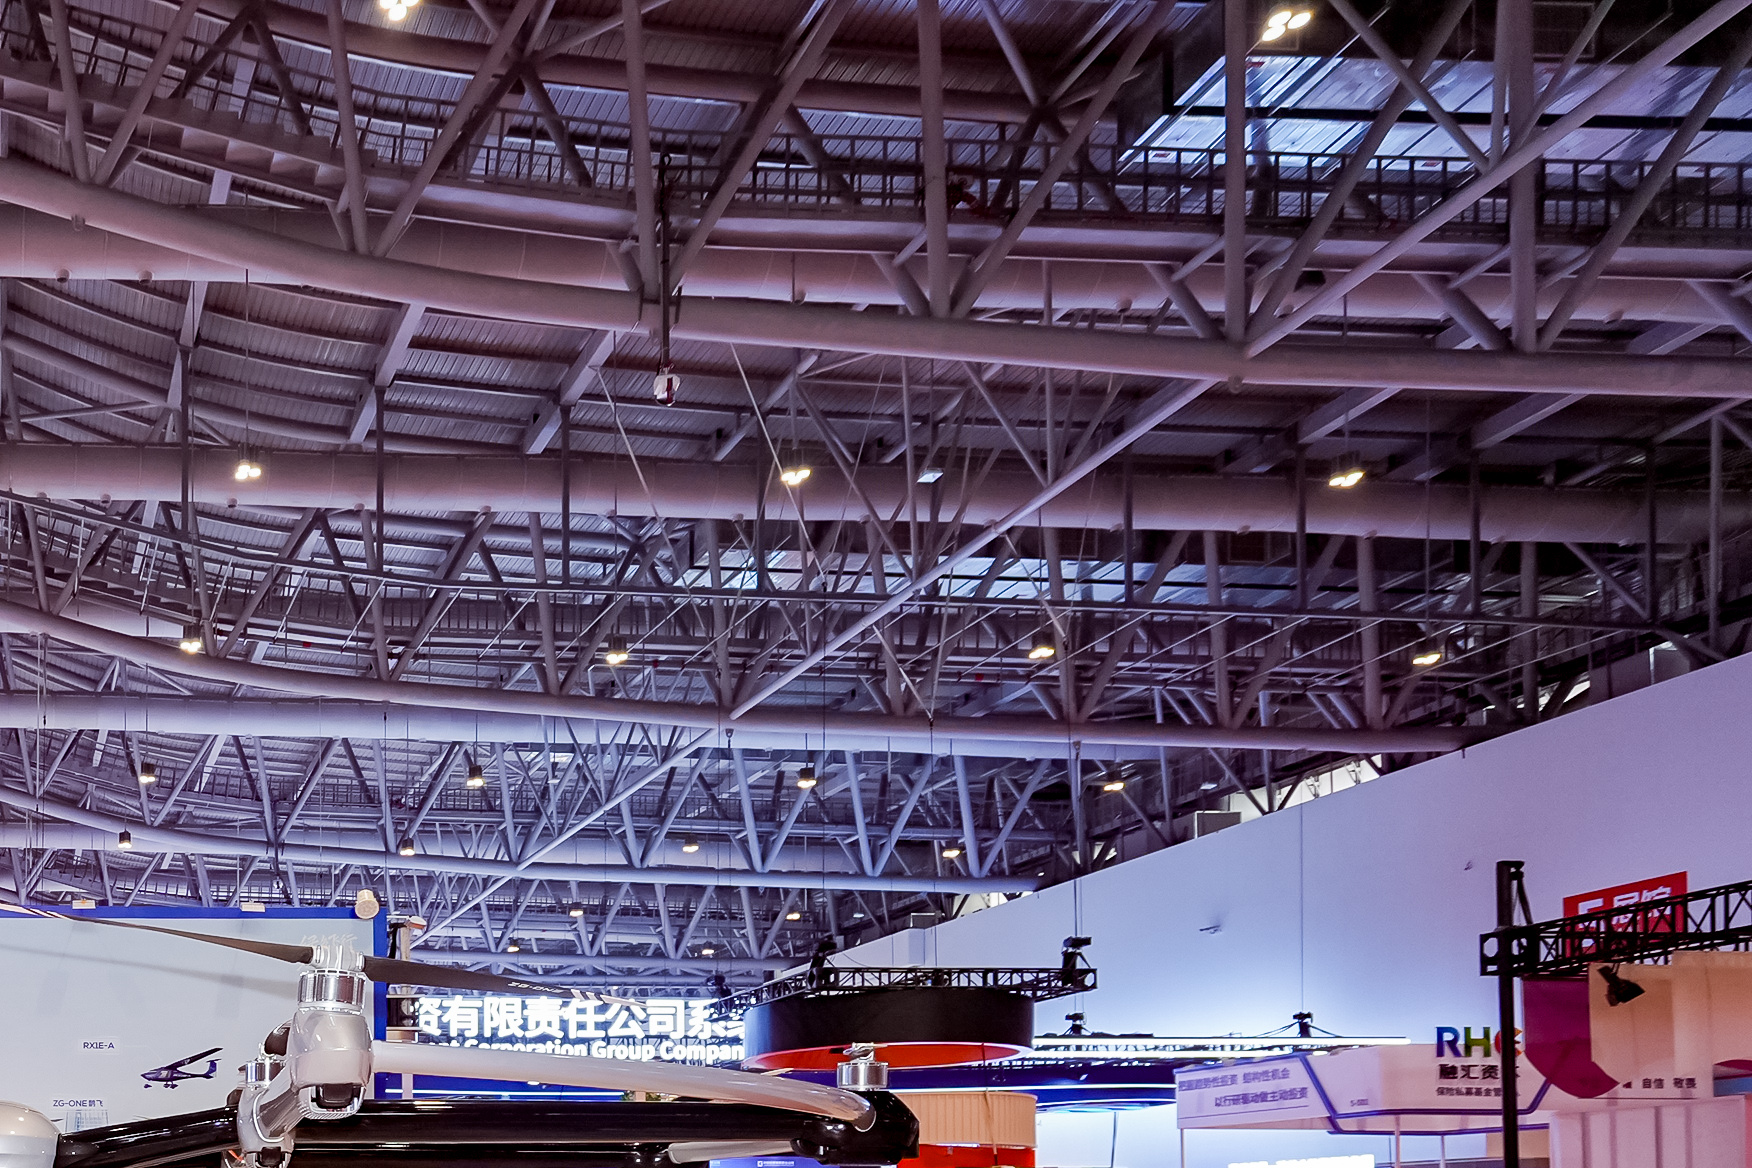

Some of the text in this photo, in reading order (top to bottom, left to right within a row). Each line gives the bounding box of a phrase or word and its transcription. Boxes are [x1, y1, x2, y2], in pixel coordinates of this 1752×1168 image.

[82, 1041, 115, 1050] RX1E-A
[591, 1041, 655, 1062] Group
[1438, 1063, 1521, 1080] 融汇资
[1436, 1086, 1520, 1097] 保险私募基金管
